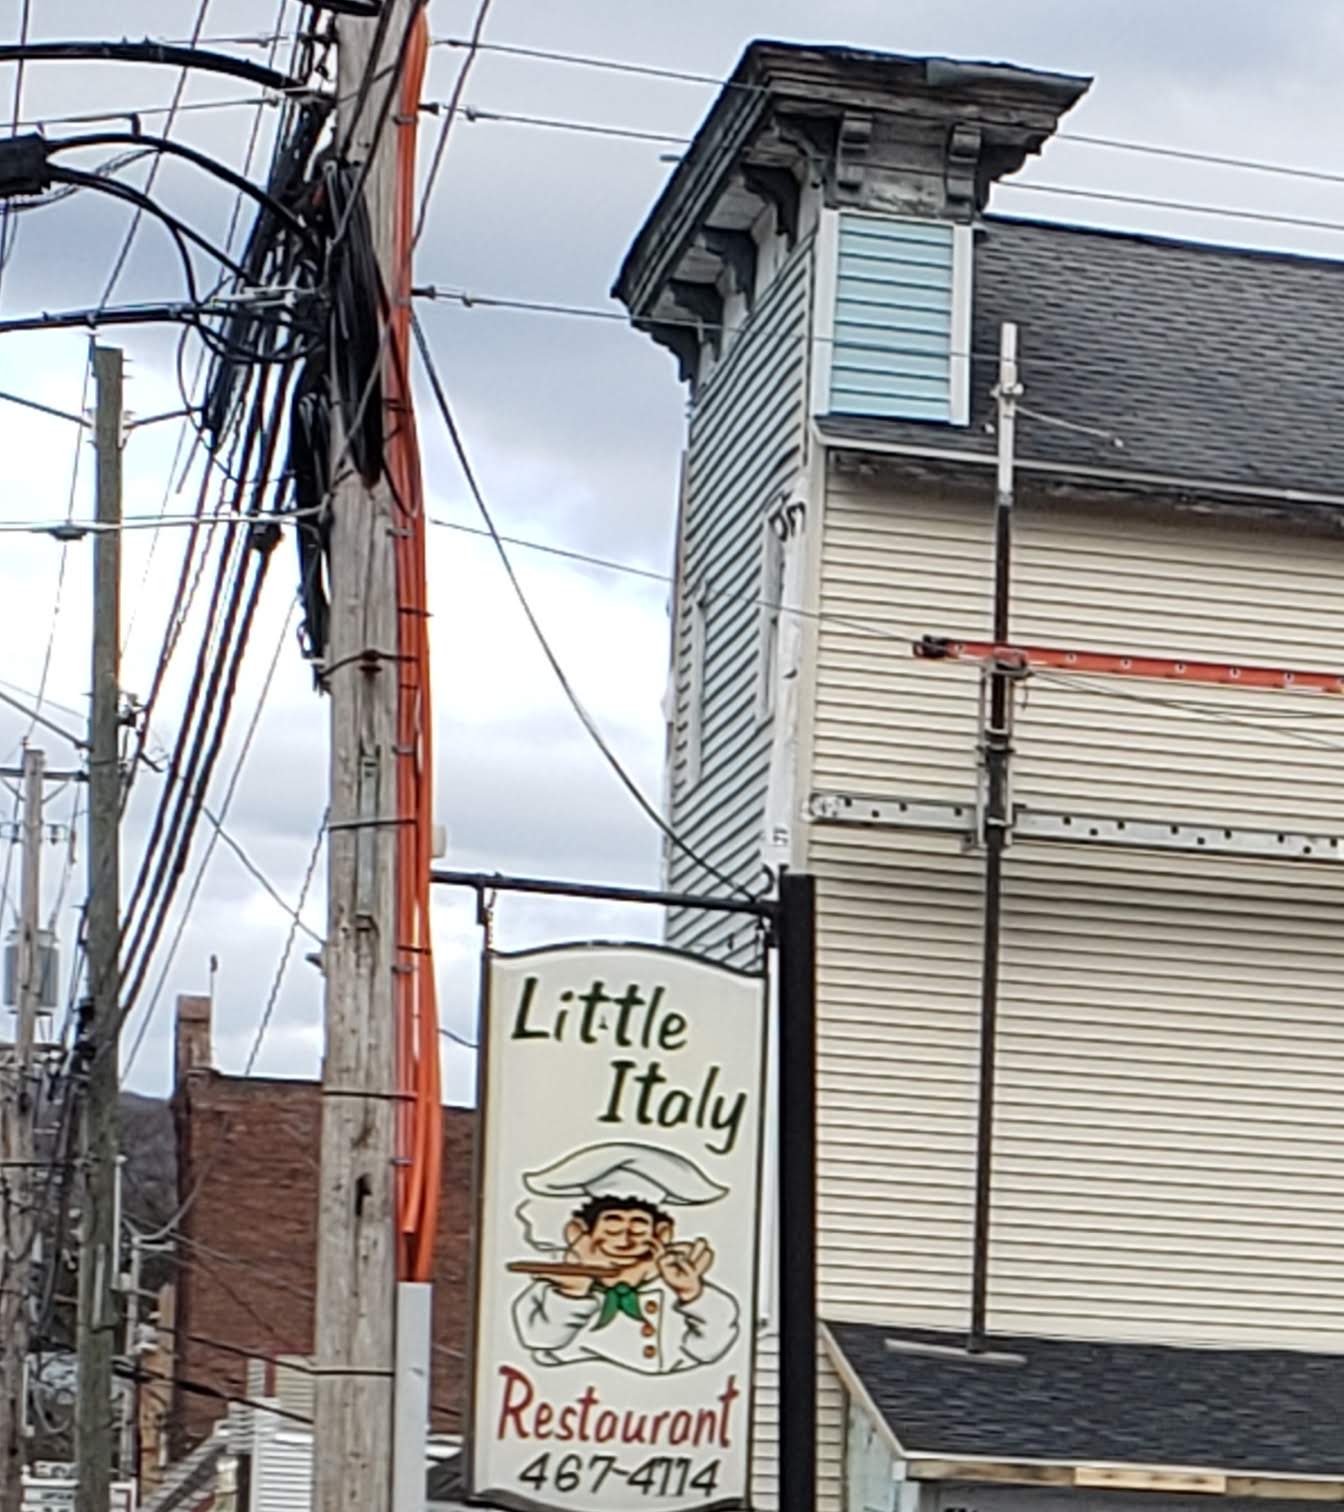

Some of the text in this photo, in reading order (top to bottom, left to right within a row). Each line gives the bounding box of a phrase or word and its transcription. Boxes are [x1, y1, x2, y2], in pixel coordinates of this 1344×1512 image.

[511, 976, 688, 1050] Little
[596, 1060, 748, 1155] Italy
[497, 1365, 740, 1447] Restaurant
